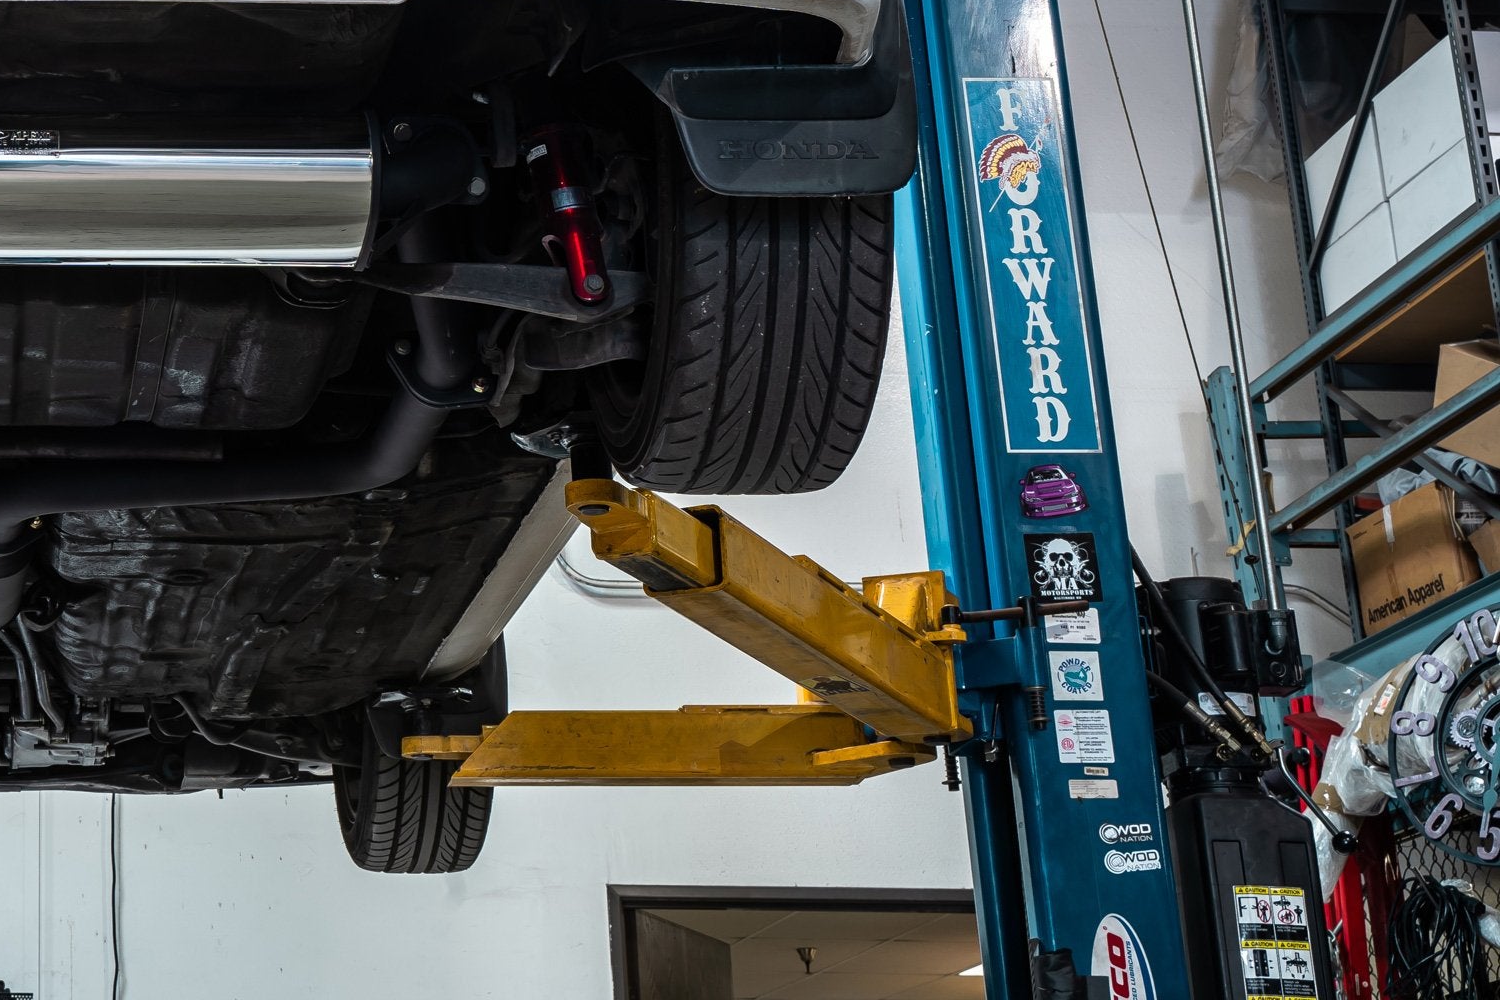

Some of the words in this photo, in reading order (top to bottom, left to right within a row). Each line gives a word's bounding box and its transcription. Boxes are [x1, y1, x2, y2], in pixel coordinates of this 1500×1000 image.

[716, 139, 880, 161] HONDA
[996, 87, 1072, 443] FORWARD
[1040, 589, 1094, 597] MOTORSPORTS
[1051, 577, 1079, 591] MA
[1366, 595, 1409, 626] American
[1406, 572, 1446, 607] Apparel
[1057, 657, 1092, 673] POWDER
[1414, 653, 1457, 694] 9
[1061, 681, 1093, 695] COATED
[1390, 710, 1436, 737] 8
[1394, 756, 1441, 788] 7
[1424, 792, 1464, 840] 6
[1119, 835, 1153, 843] NATION
[1126, 862, 1160, 871] NATION
[1125, 940, 1137, 986] LUBRICANTS
